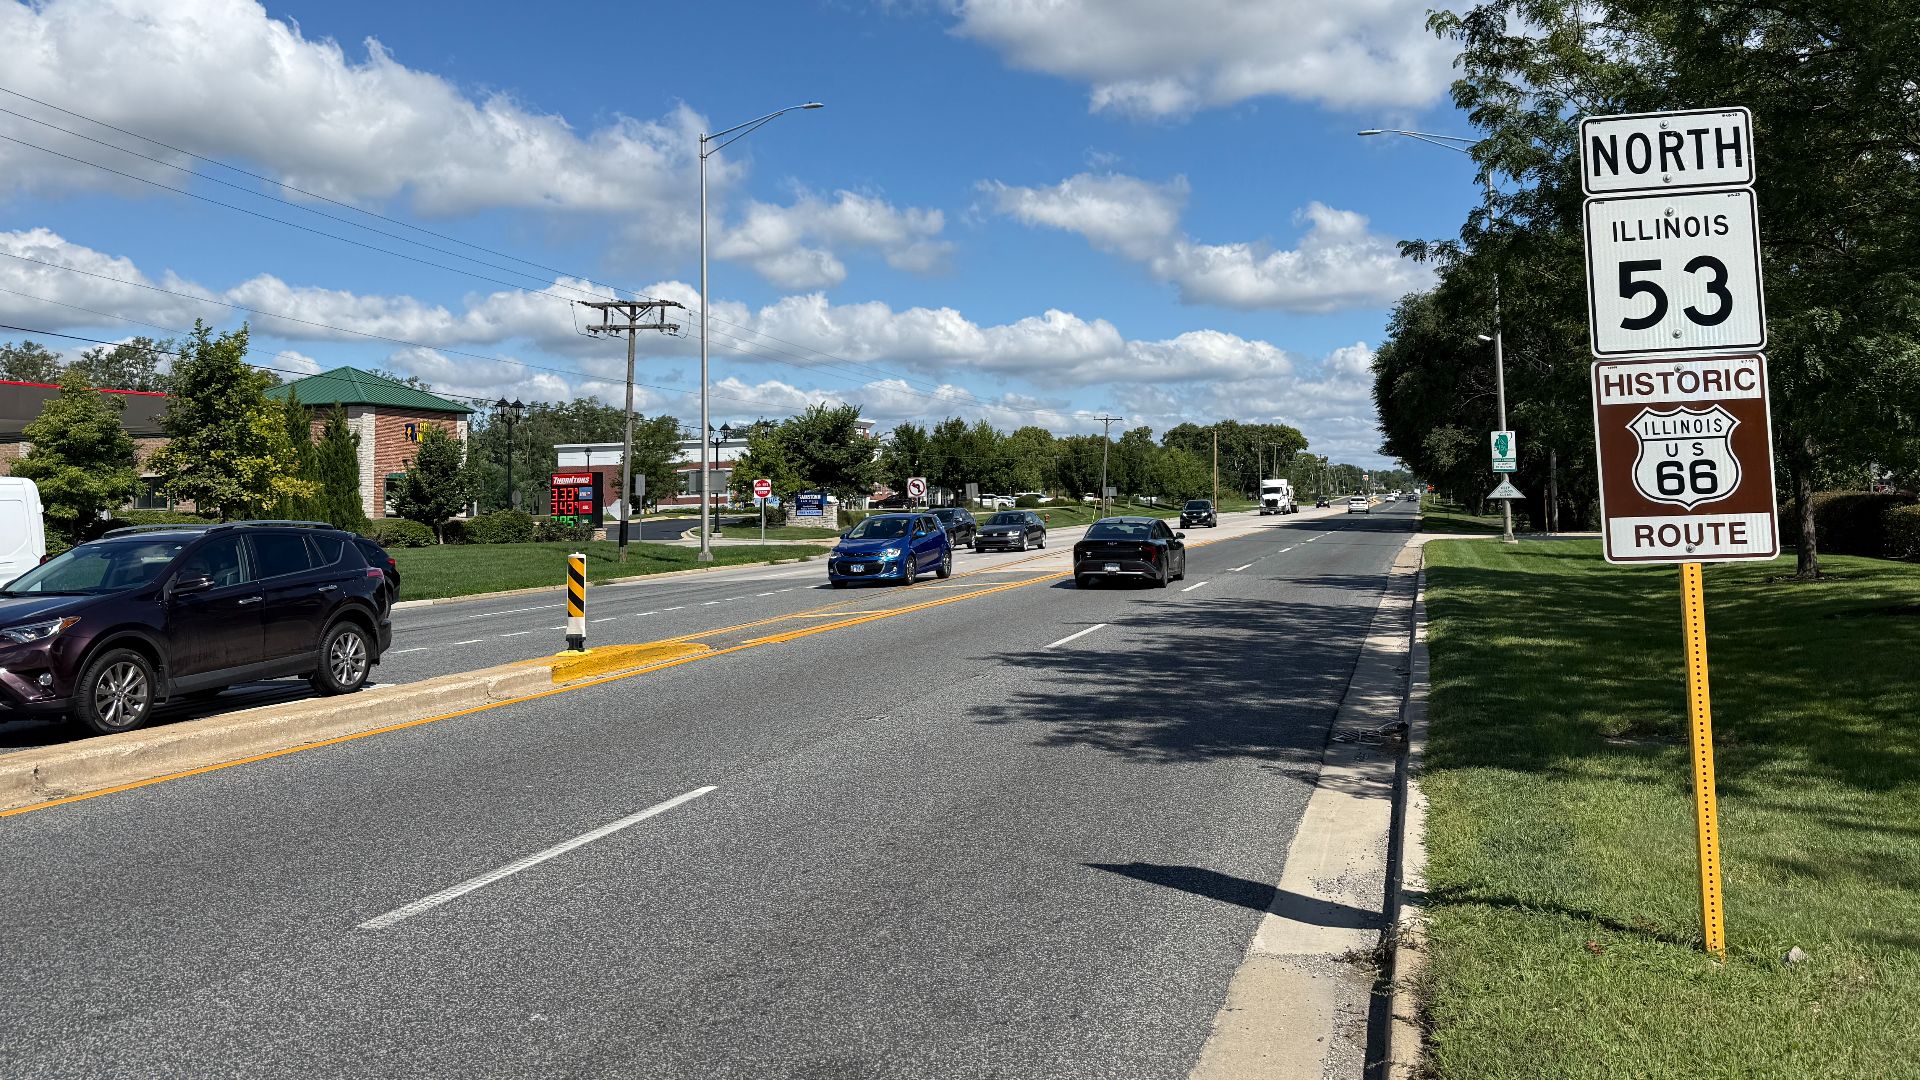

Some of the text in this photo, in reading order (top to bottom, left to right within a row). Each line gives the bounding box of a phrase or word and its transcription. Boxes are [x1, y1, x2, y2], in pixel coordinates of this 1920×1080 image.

[1592, 126, 1743, 177] NORTH
[1612, 214, 1729, 243] ILLINOIS
[1618, 255, 1733, 331] 53
[1604, 367, 1756, 397] HISTORIC
[1644, 418, 1723, 436] ILLINOIS
[1665, 441, 1704, 458] U S
[1656, 459, 1718, 496] 66
[1634, 521, 1748, 548] ROUTE
